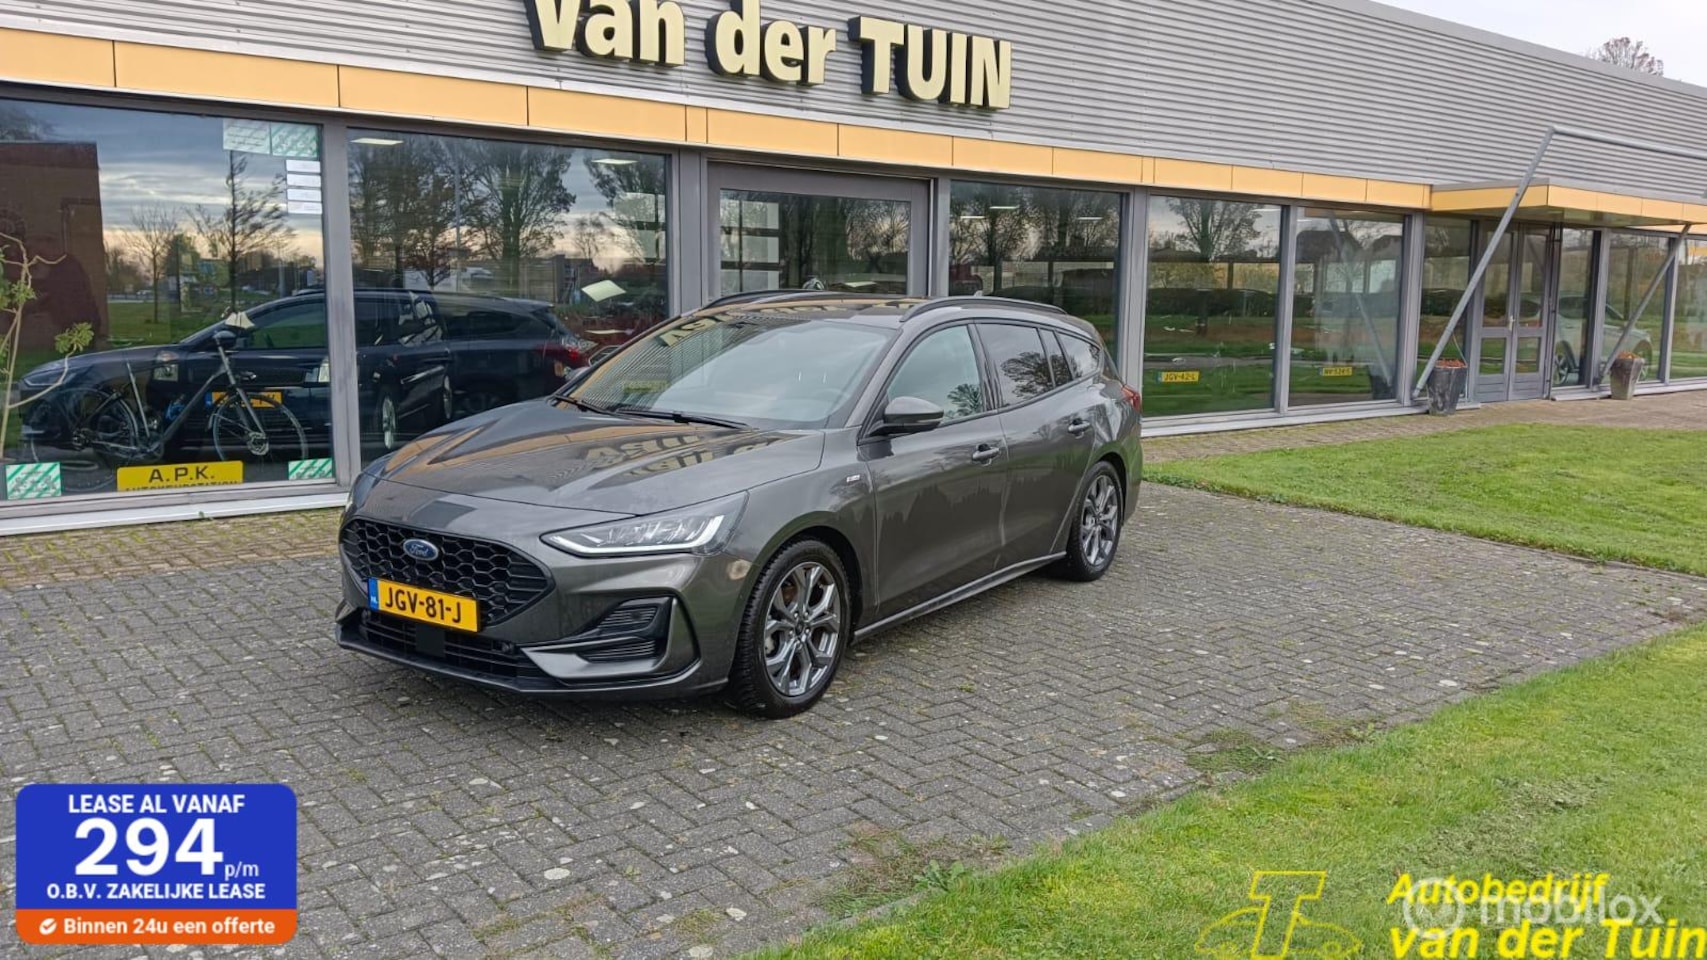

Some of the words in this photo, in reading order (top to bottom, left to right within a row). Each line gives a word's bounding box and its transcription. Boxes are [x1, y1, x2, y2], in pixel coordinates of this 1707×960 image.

[531, 0, 684, 66] van
[711, 0, 836, 84] der
[857, 16, 1011, 108] TUIN
[148, 465, 215, 483] A.P.K.
[385, 587, 461, 623] JGV-81-J
